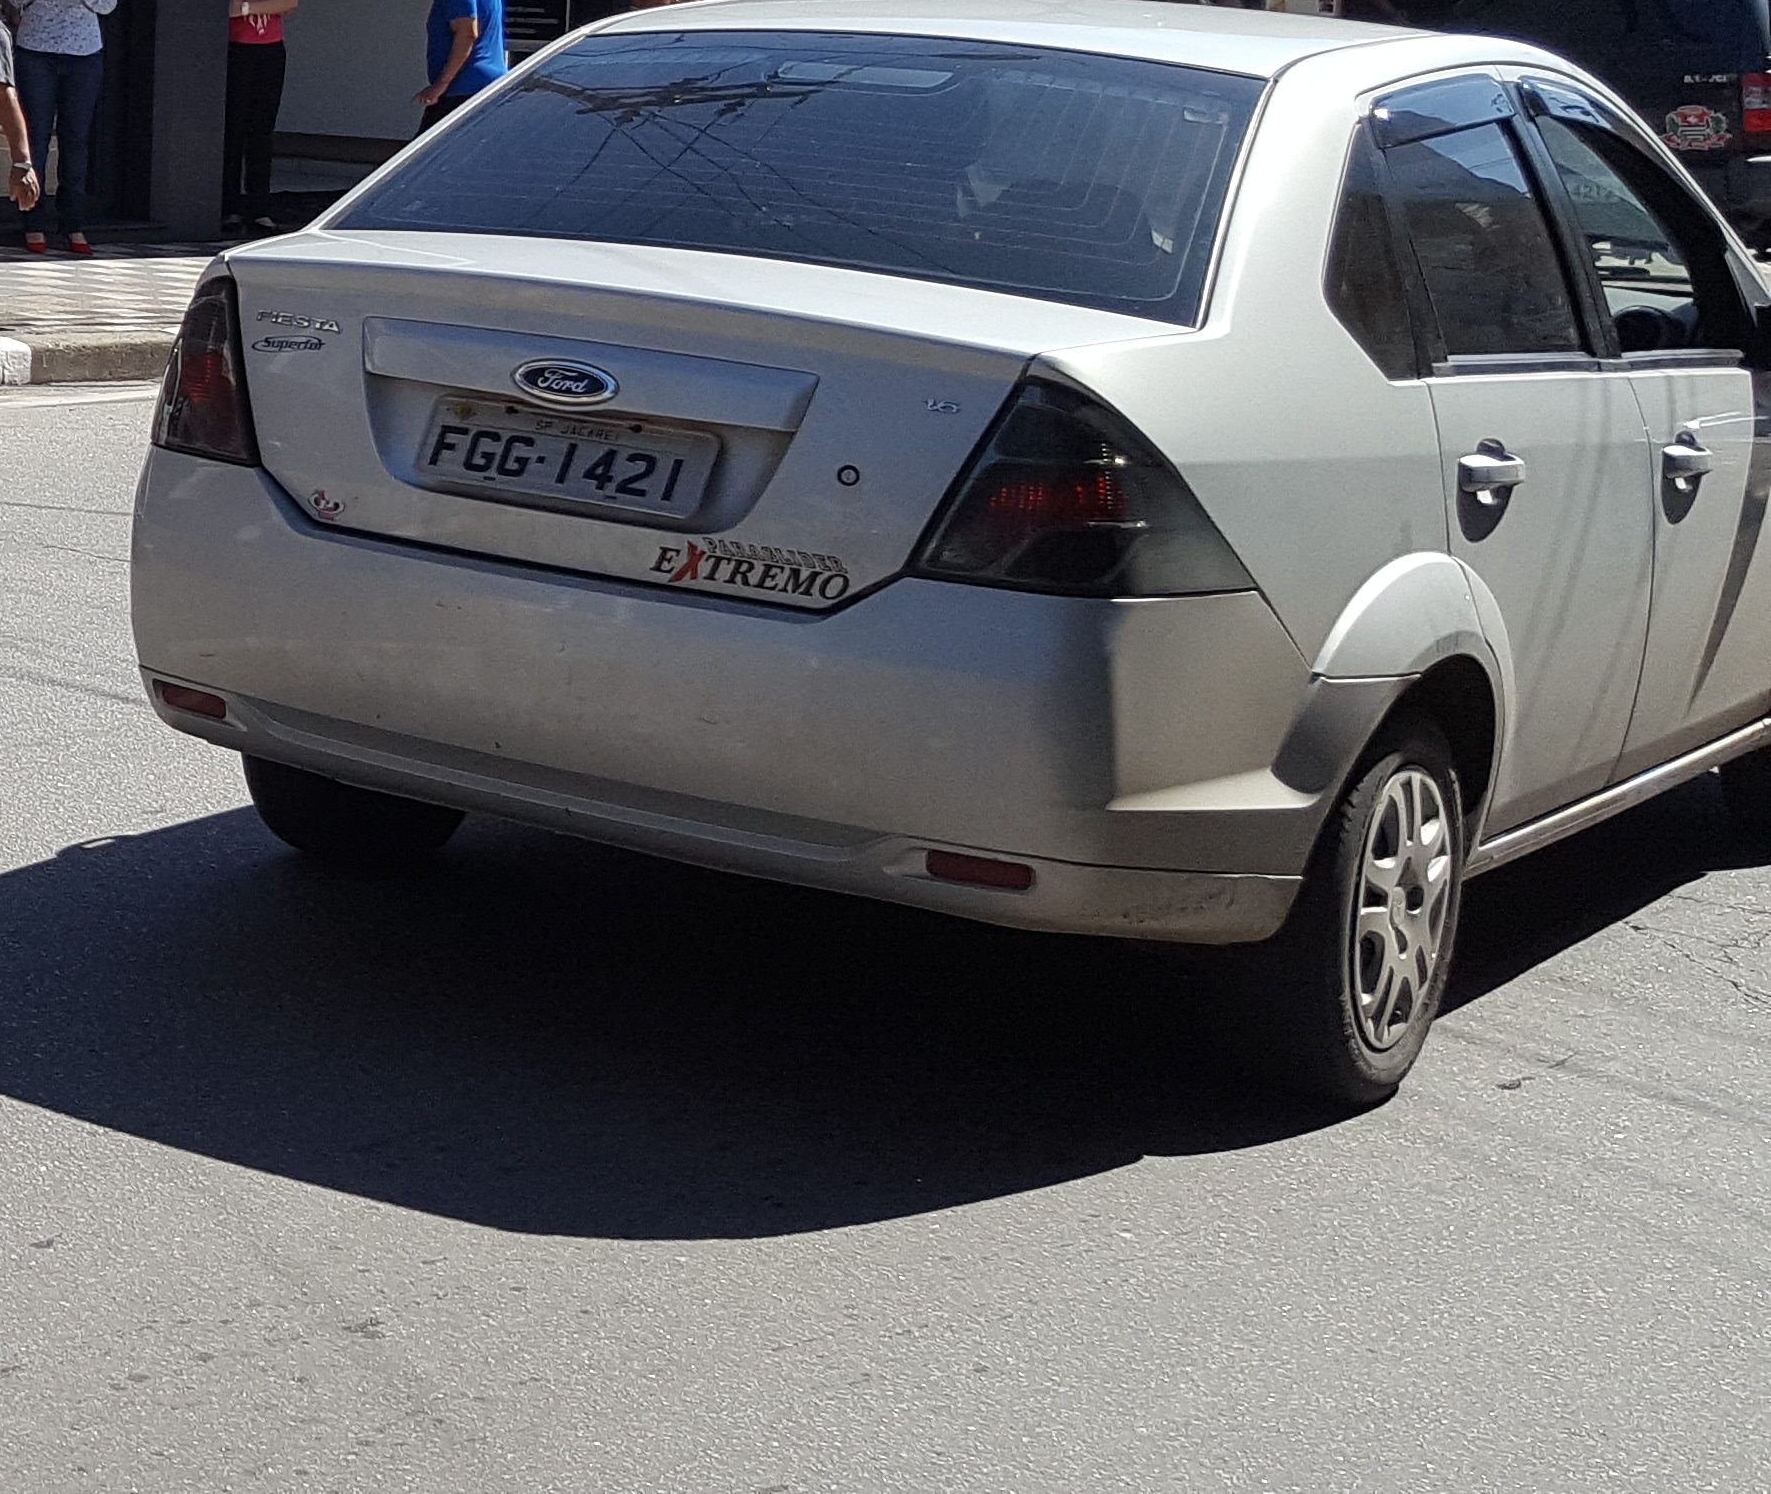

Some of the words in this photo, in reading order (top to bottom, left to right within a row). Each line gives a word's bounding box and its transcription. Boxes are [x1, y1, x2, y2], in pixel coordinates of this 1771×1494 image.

[256, 309, 342, 334] FIESTA
[536, 368, 590, 394] Ford
[534, 418, 553, 431] SP
[649, 539, 851, 601] EXTREMO
